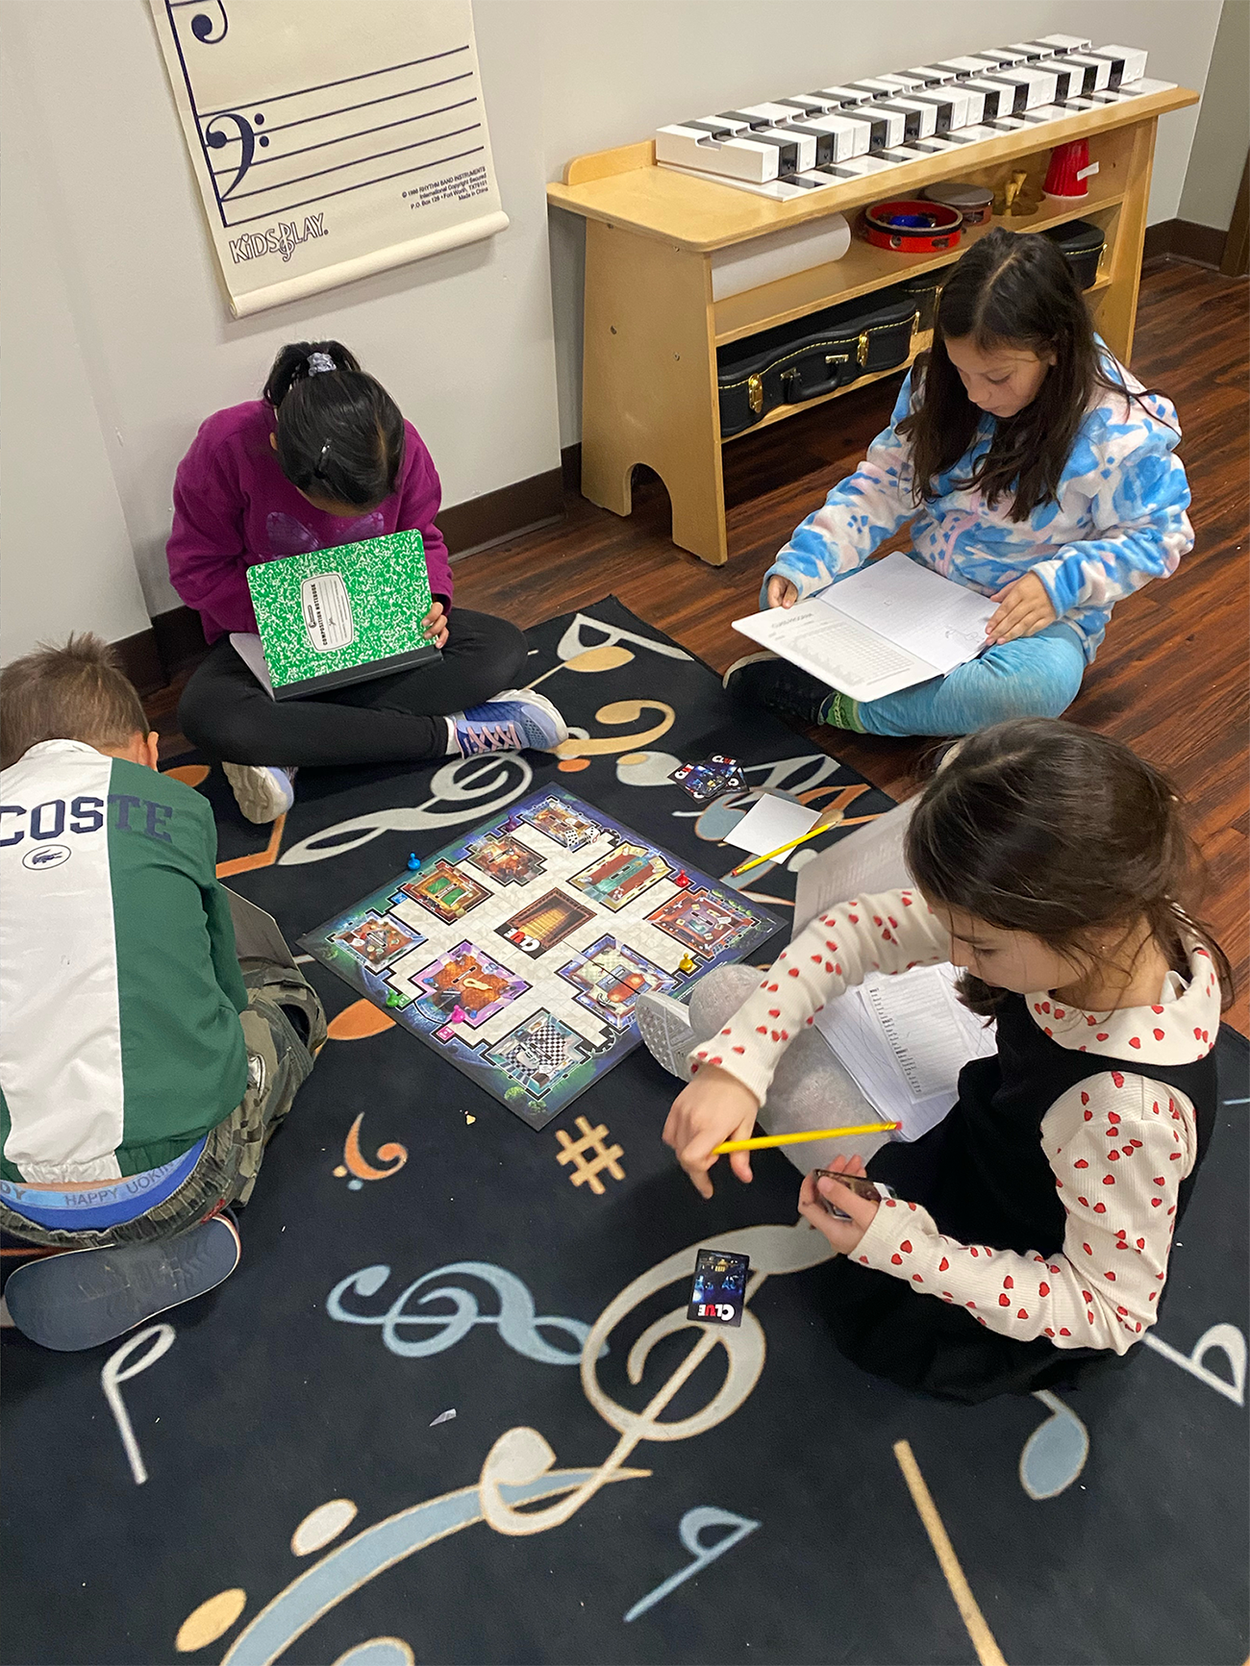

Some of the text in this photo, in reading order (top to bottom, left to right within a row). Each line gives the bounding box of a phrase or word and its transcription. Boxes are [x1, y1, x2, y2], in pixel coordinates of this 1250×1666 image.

[440, 177, 454, 187] BAND
[454, 166, 486, 181] INSTRUMENTS
[419, 173, 487, 199] International Copyright Secured
[443, 191, 453, 199] Fort
[458, 193, 471, 201] Made
[475, 187, 489, 195] China
[712, 755, 737, 766] CLUE
[674, 764, 695, 780] CLUE
[503, 927, 541, 952] CLUE
[64, 1187, 119, 1207] HAPPY
[697, 1303, 735, 1321] CLUE
